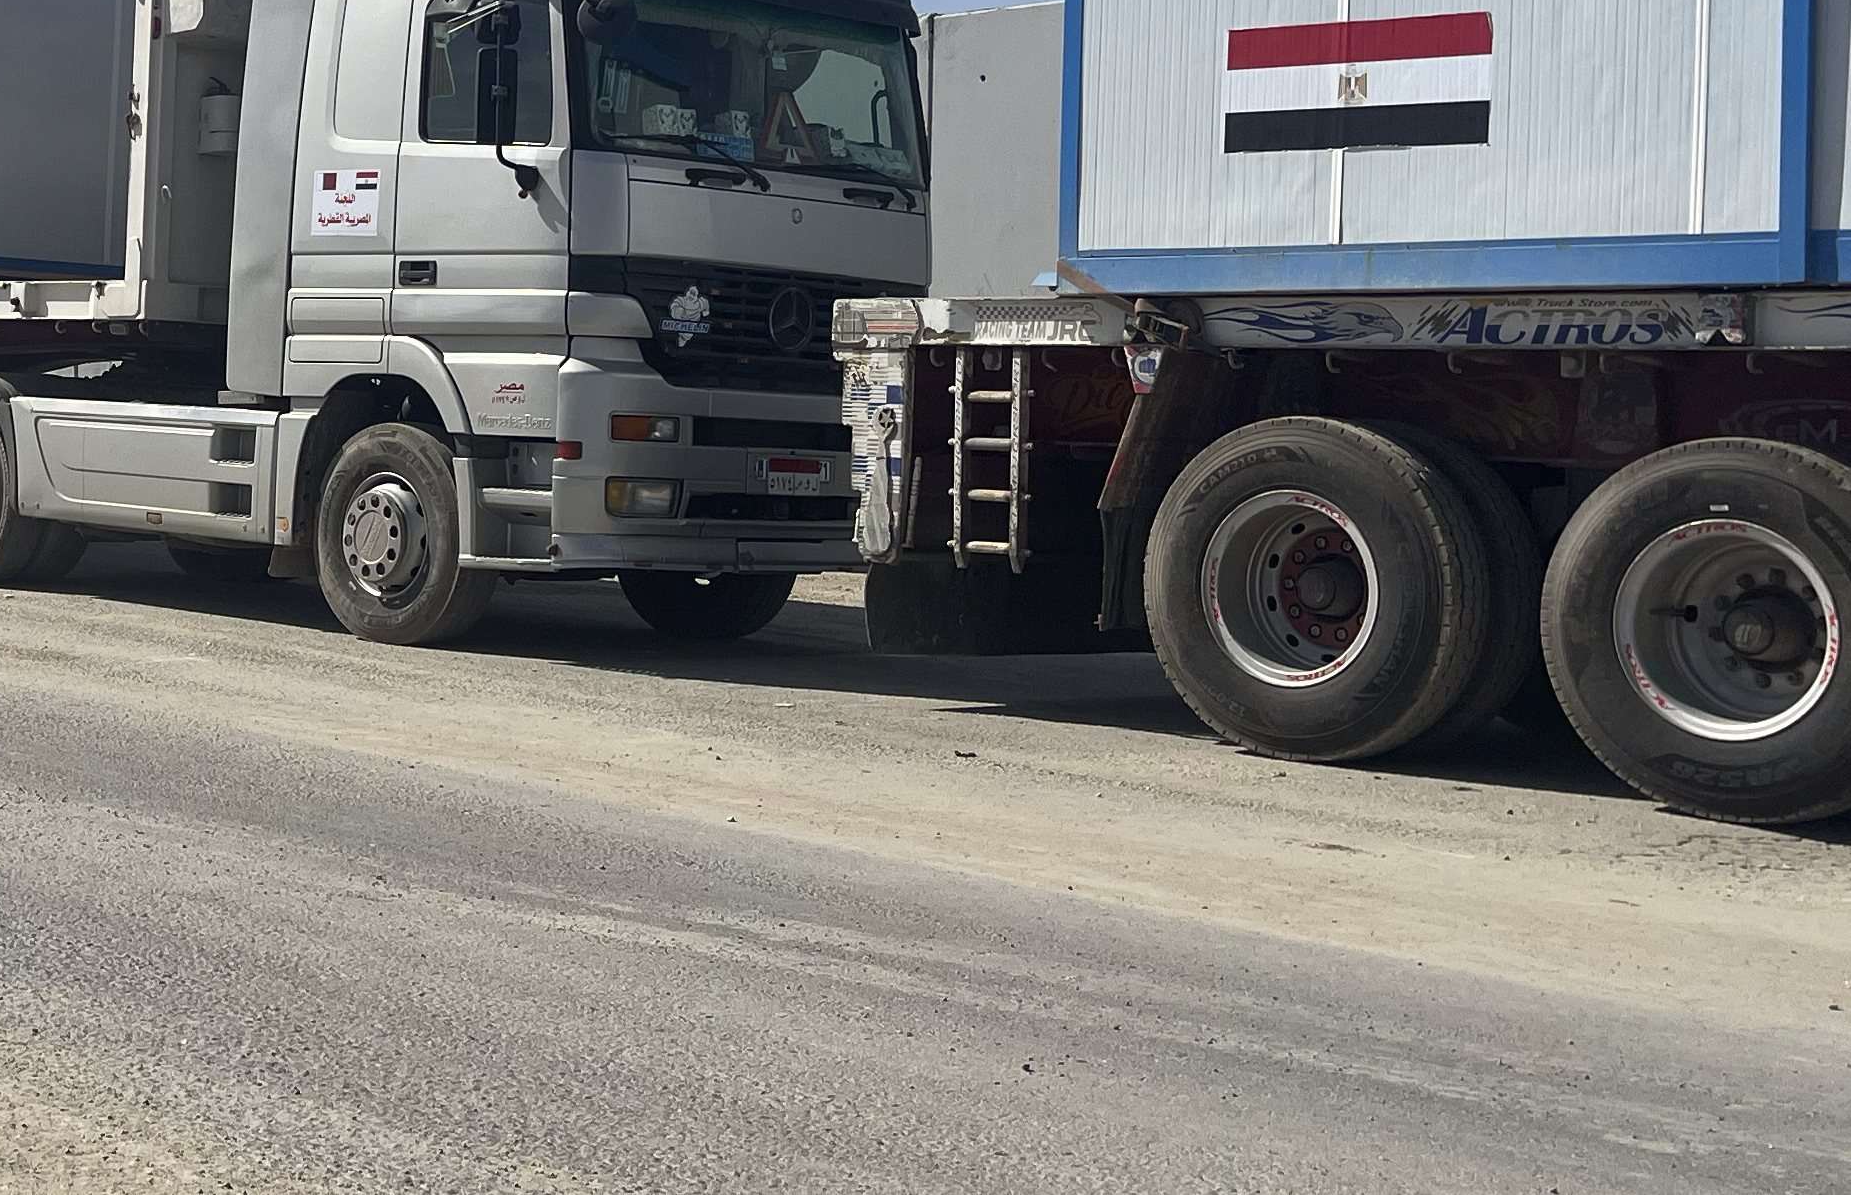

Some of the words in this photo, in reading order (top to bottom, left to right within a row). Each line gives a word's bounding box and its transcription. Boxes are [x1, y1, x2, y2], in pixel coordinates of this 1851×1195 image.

[334, 192, 356, 207] اللجنة
[317, 212, 345, 227] القطرية
[345, 211, 372, 227] المصرية
[662, 320, 708, 334] MICHELIN
[972, 320, 1013, 339] RACING
[1014, 320, 1047, 340] TEAM
[1437, 306, 1667, 345] ACTROS
[494, 383, 525, 393] مصر
